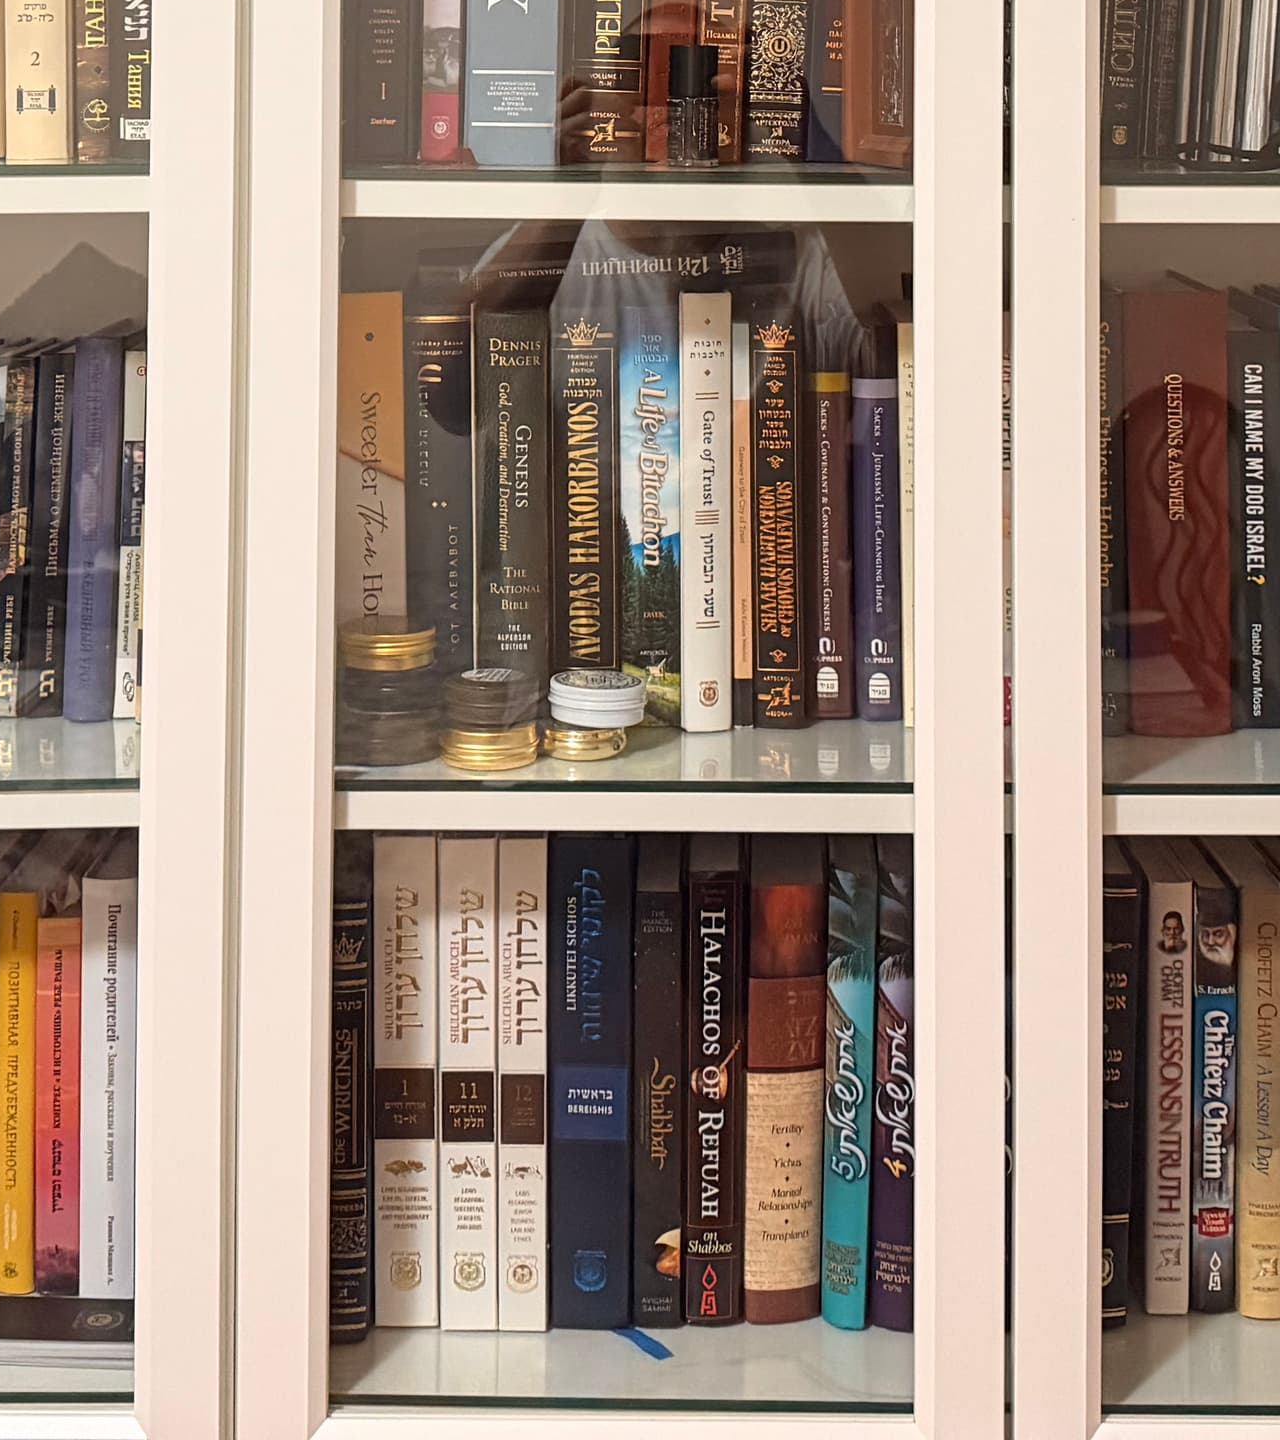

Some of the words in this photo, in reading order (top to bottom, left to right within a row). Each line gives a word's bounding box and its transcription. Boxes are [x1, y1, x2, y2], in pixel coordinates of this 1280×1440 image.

[490, 339, 540, 352] DENNIS
[490, 354, 540, 367] PRAGER
[1244, 364, 1262, 395] CAN
[703, 411, 715, 446] Gate
[1164, 374, 1183, 447] QUESTIONS
[1245, 409, 1262, 450] NAME
[514, 425, 532, 509] GENESIS
[703, 449, 718, 464] of
[1168, 448, 1183, 462] &
[1246, 454, 1263, 478] MY
[568, 401, 599, 563] HAKORBANOS
[703, 468, 714, 505] Trust
[1168, 465, 1185, 522] ANSWERS
[1246, 482, 1264, 512] DOG
[642, 452, 669, 567] Bitachon
[569, 572, 601, 663] AVODAS
[1252, 624, 1262, 654] Rabbi
[1252, 658, 1262, 682] Aron
[1251, 686, 1262, 716] Moss
[567, 896, 577, 944] SICHOS
[105, 905, 121, 976] Почитание
[567, 951, 577, 1011] LIKKUTEI
[700, 909, 725, 1058] HALACHOS
[103, 980, 120, 1042] родителей
[1202, 1010, 1230, 1098] Chafetz
[568, 1087, 613, 1100] בראשית
[700, 1069, 722, 1103] OF
[1202, 1102, 1230, 1180] Chaim
[699, 1110, 724, 1219] REFUAH
[688, 1239, 733, 1254] Shabbos
